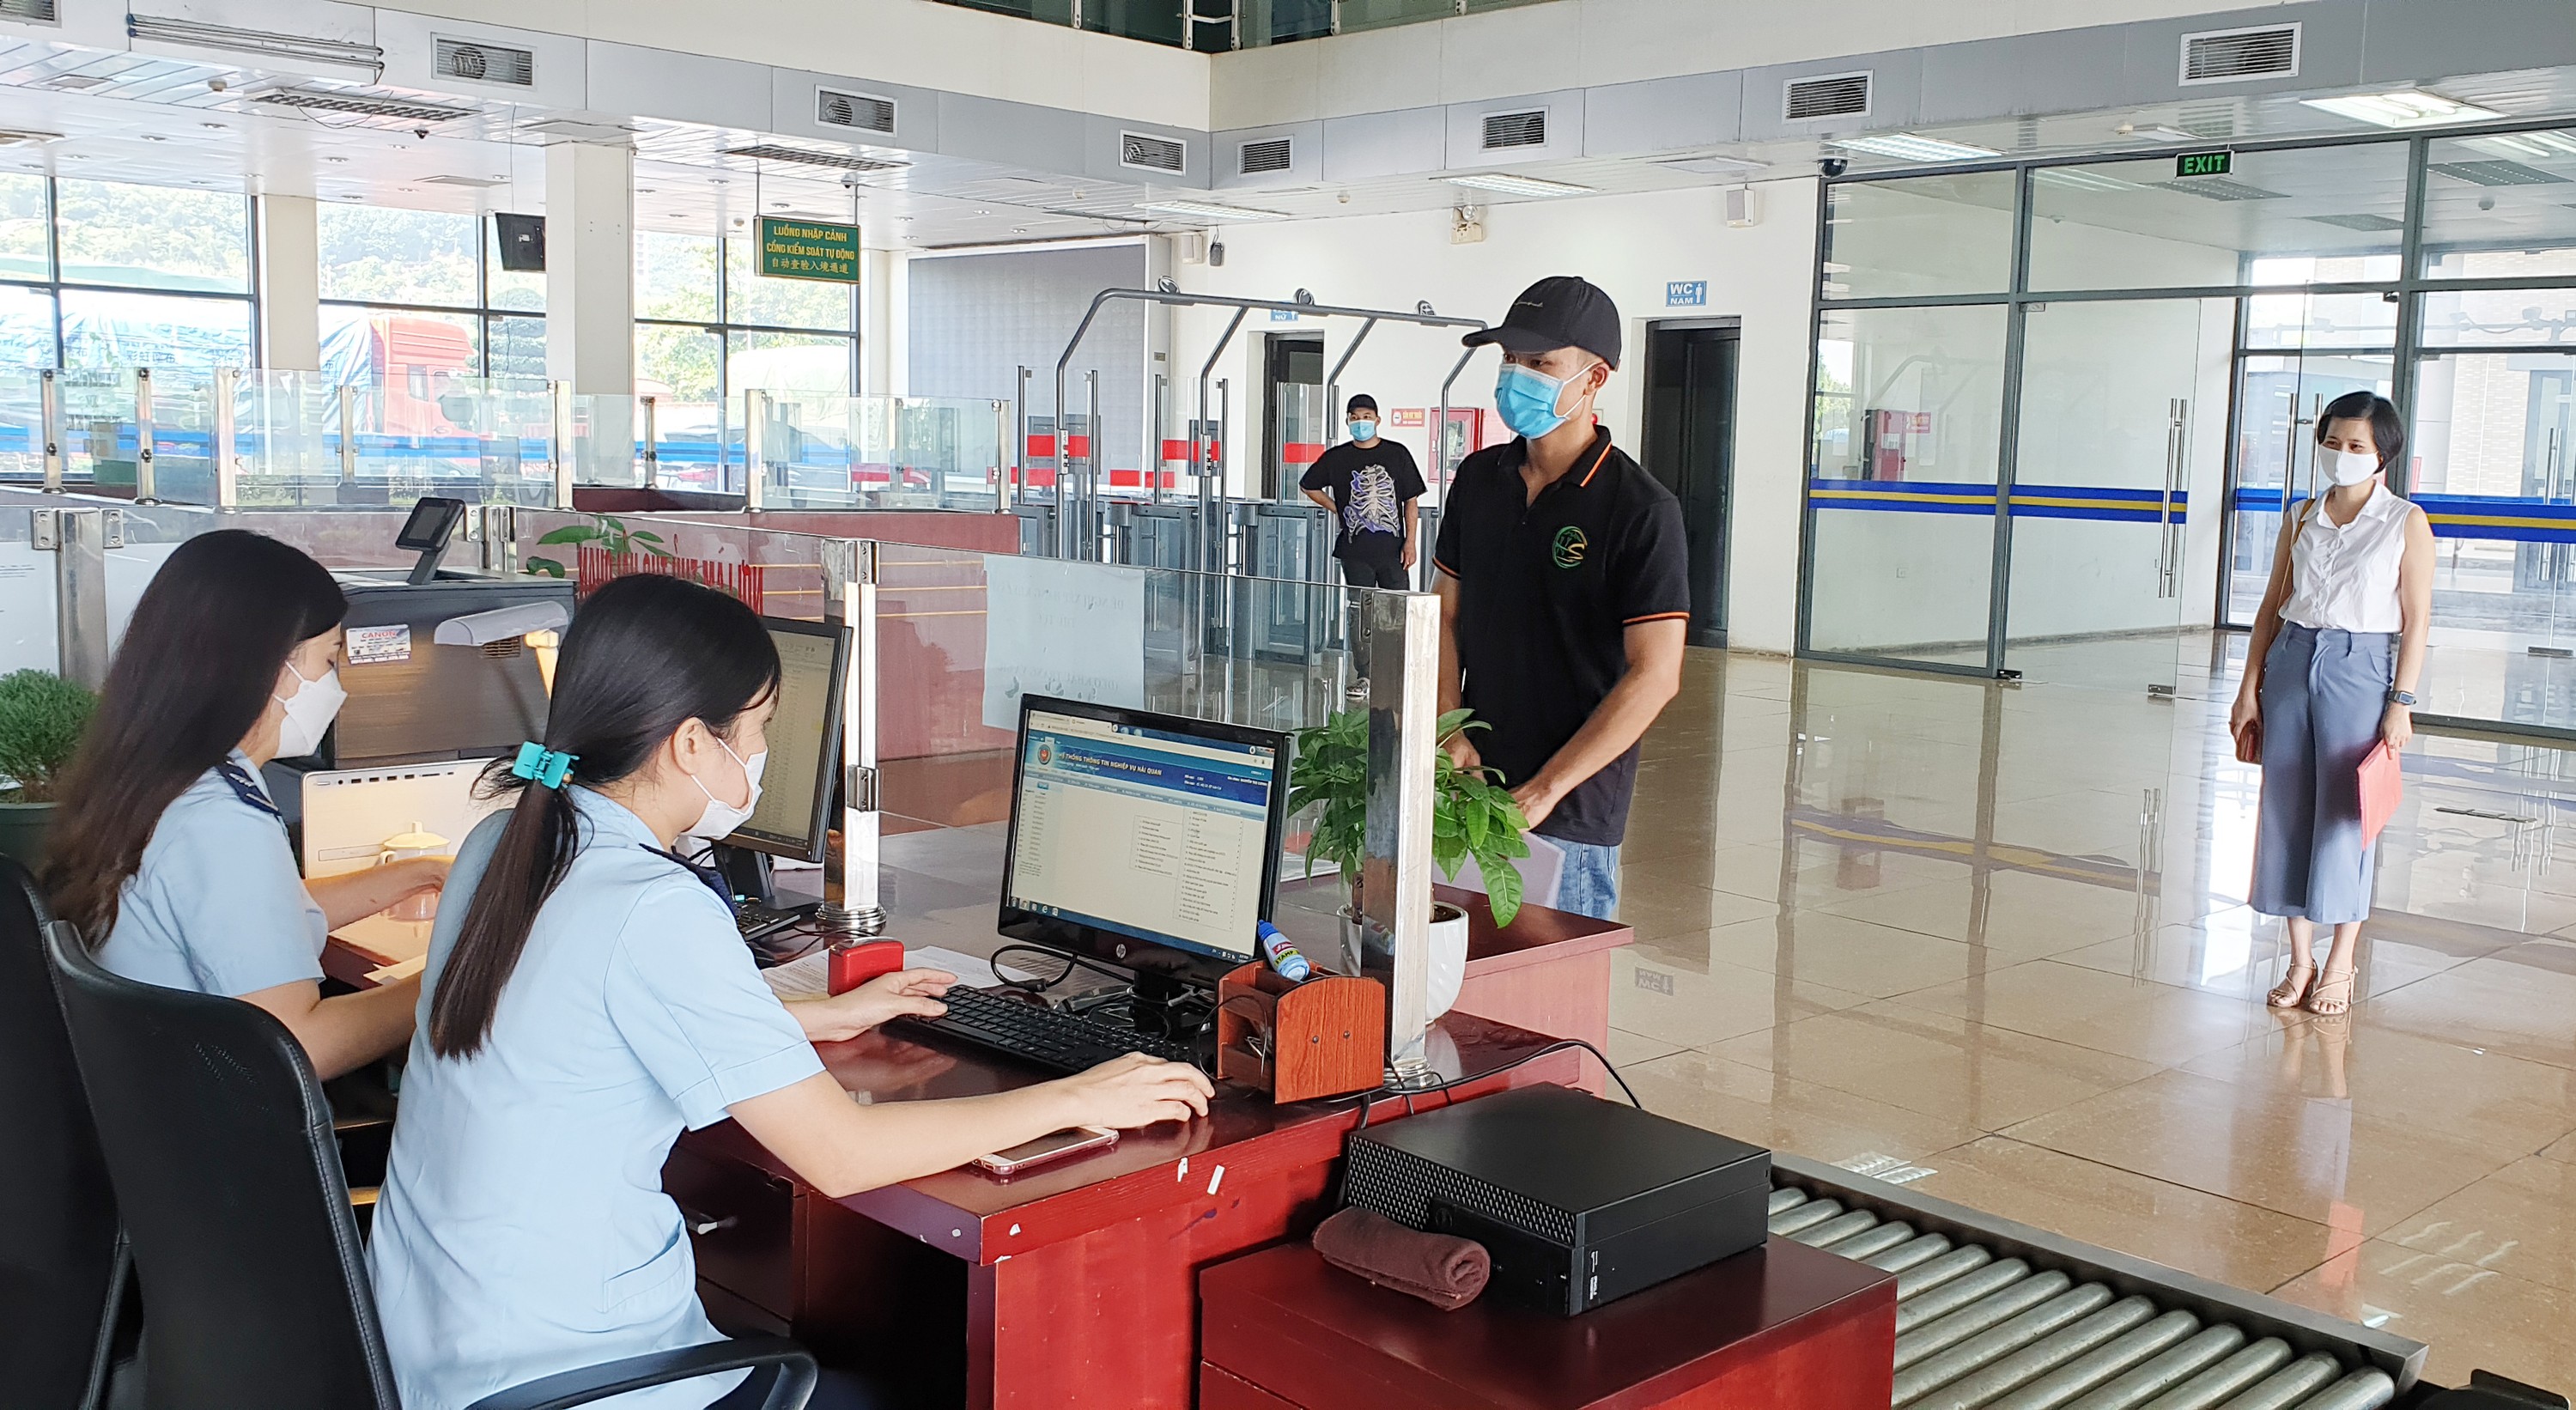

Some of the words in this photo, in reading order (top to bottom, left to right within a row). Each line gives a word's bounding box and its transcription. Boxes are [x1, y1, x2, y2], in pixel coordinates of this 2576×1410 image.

[2184, 155, 2225, 173] EXIT
[774, 224, 800, 238] LUỒNG
[802, 228, 824, 240] NHẬP
[825, 228, 848, 242] CẢNH
[787, 241, 805, 255] KIỂM
[806, 246, 823, 258] SOÁT
[1670, 283, 1693, 295] WC
[1146, 768, 1163, 776] QUAN
